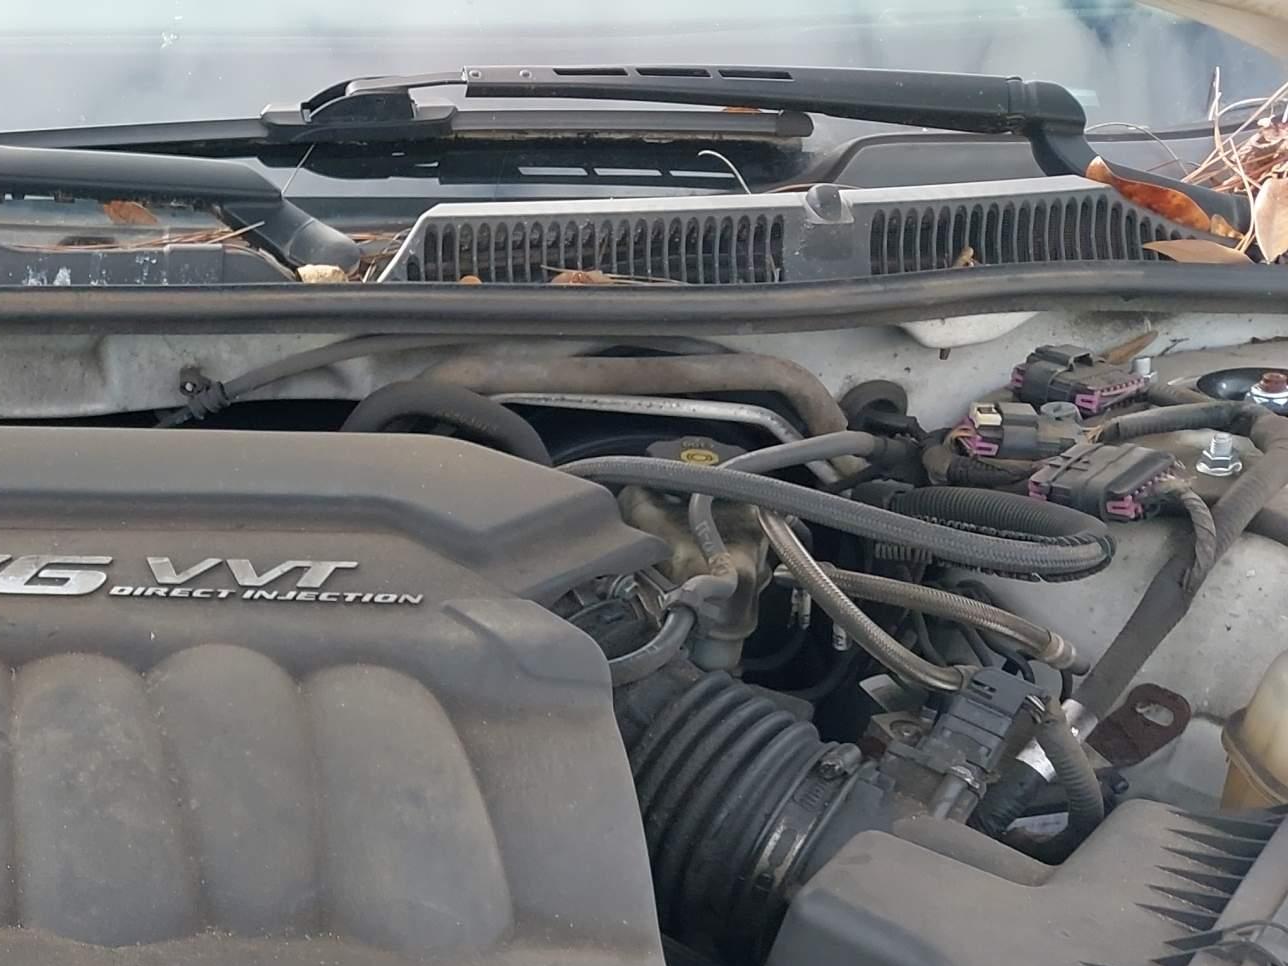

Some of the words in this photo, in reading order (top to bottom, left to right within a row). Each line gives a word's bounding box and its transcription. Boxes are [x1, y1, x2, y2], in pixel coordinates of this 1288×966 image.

[146, 556, 359, 589] VVT
[108, 584, 236, 600] DIRECT
[242, 588, 424, 605] INJECTION
